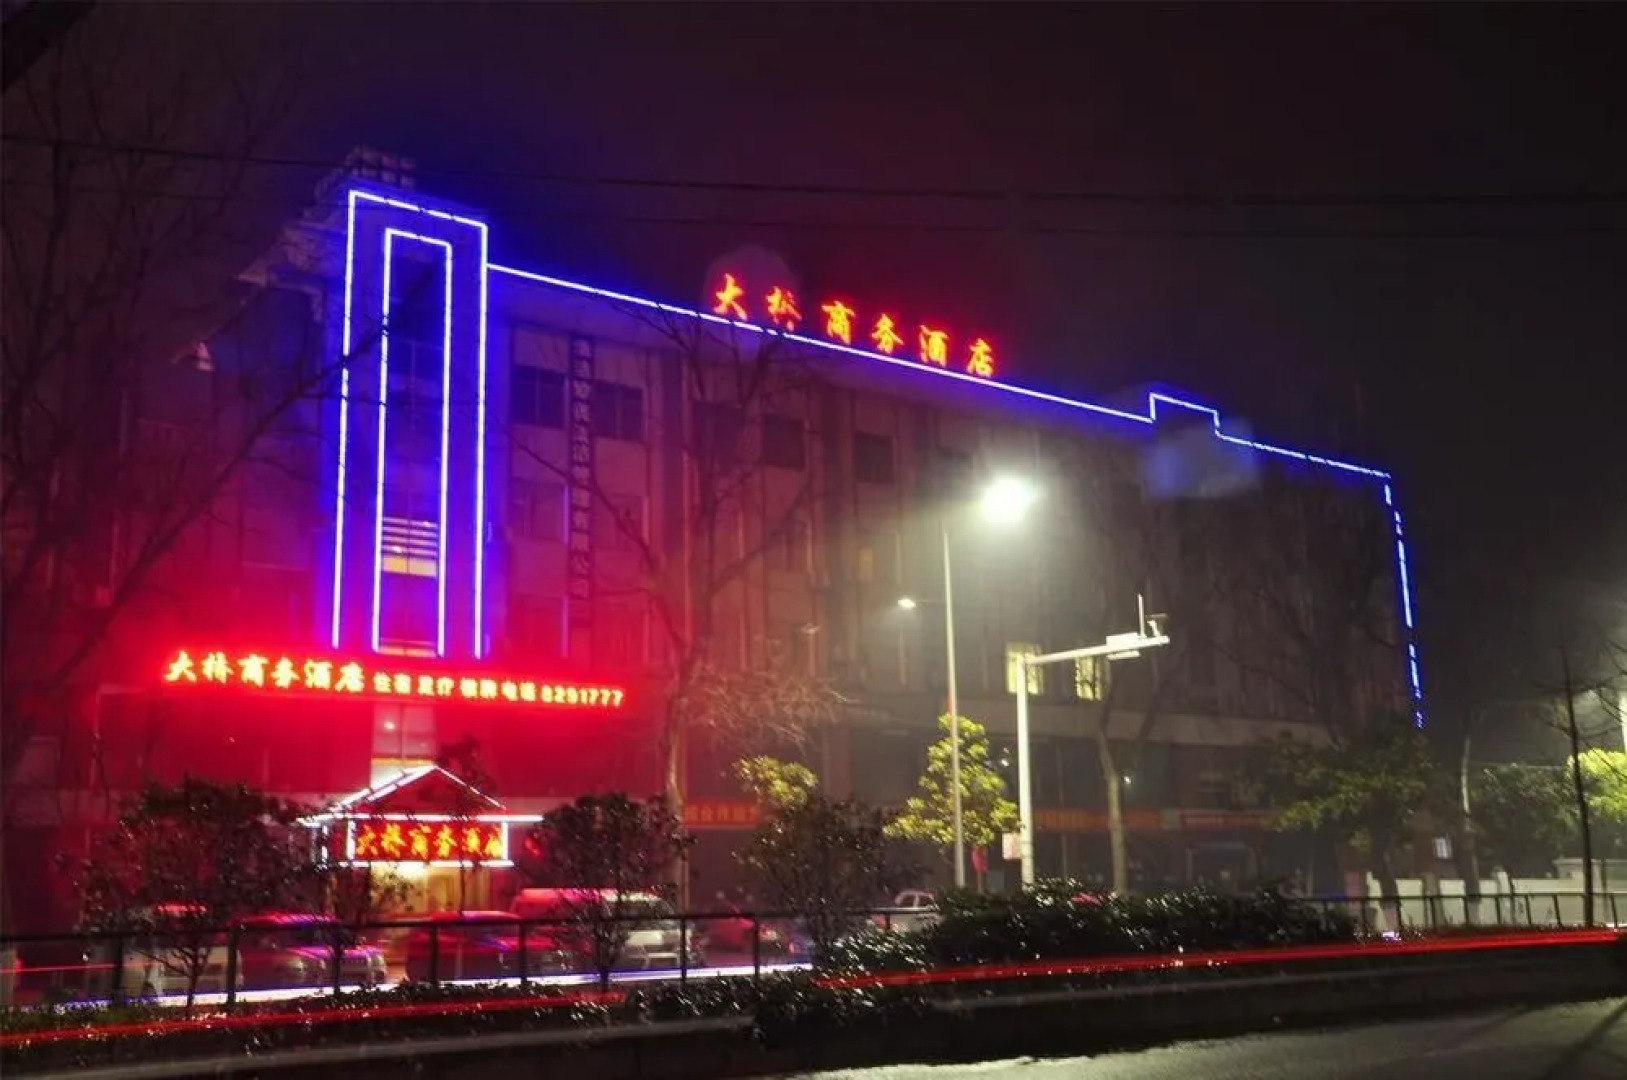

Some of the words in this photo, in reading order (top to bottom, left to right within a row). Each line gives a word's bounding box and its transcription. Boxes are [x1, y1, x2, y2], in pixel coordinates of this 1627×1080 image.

[713, 272, 994, 378] 大桥商务酒店
[164, 650, 365, 694] 大桥商务酒店
[356, 823, 504, 860] 大桥商务酒店
